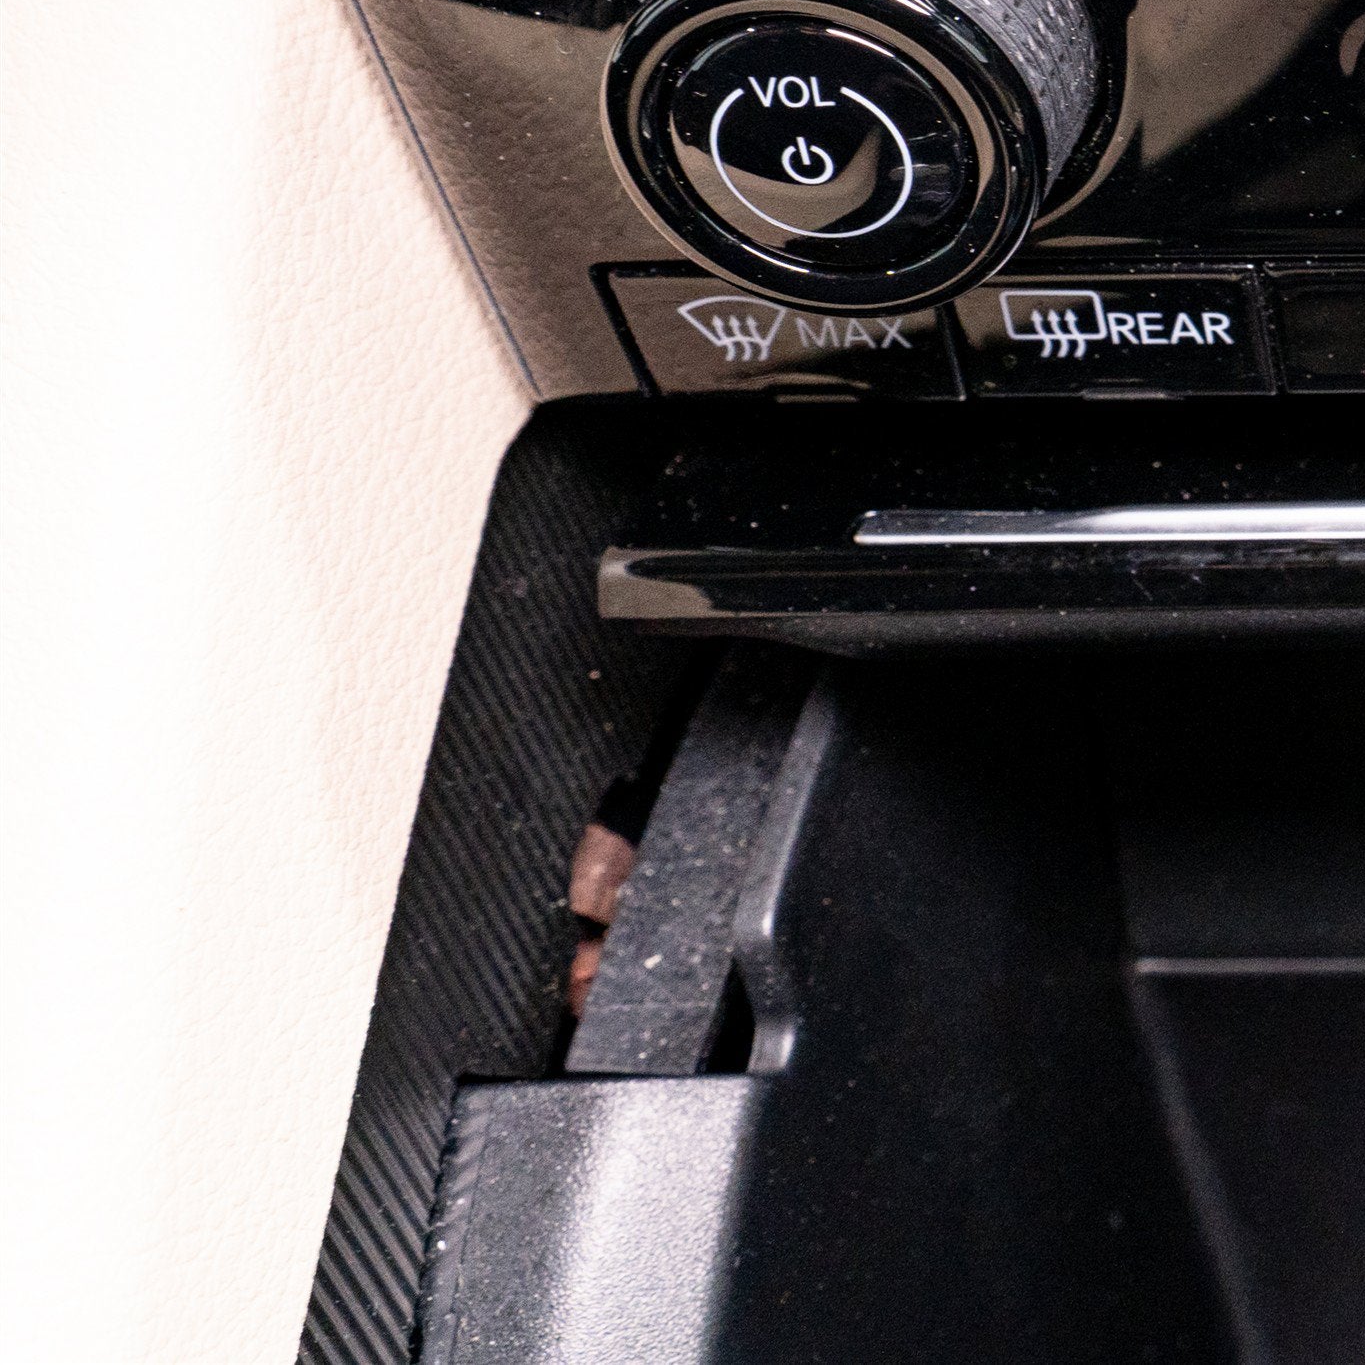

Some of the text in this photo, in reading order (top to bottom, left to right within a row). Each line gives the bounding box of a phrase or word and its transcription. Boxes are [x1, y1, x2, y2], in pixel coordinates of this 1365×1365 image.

[749, 76, 835, 108] VOL
[796, 317, 913, 350] MAX
[1108, 312, 1234, 345] REAR
